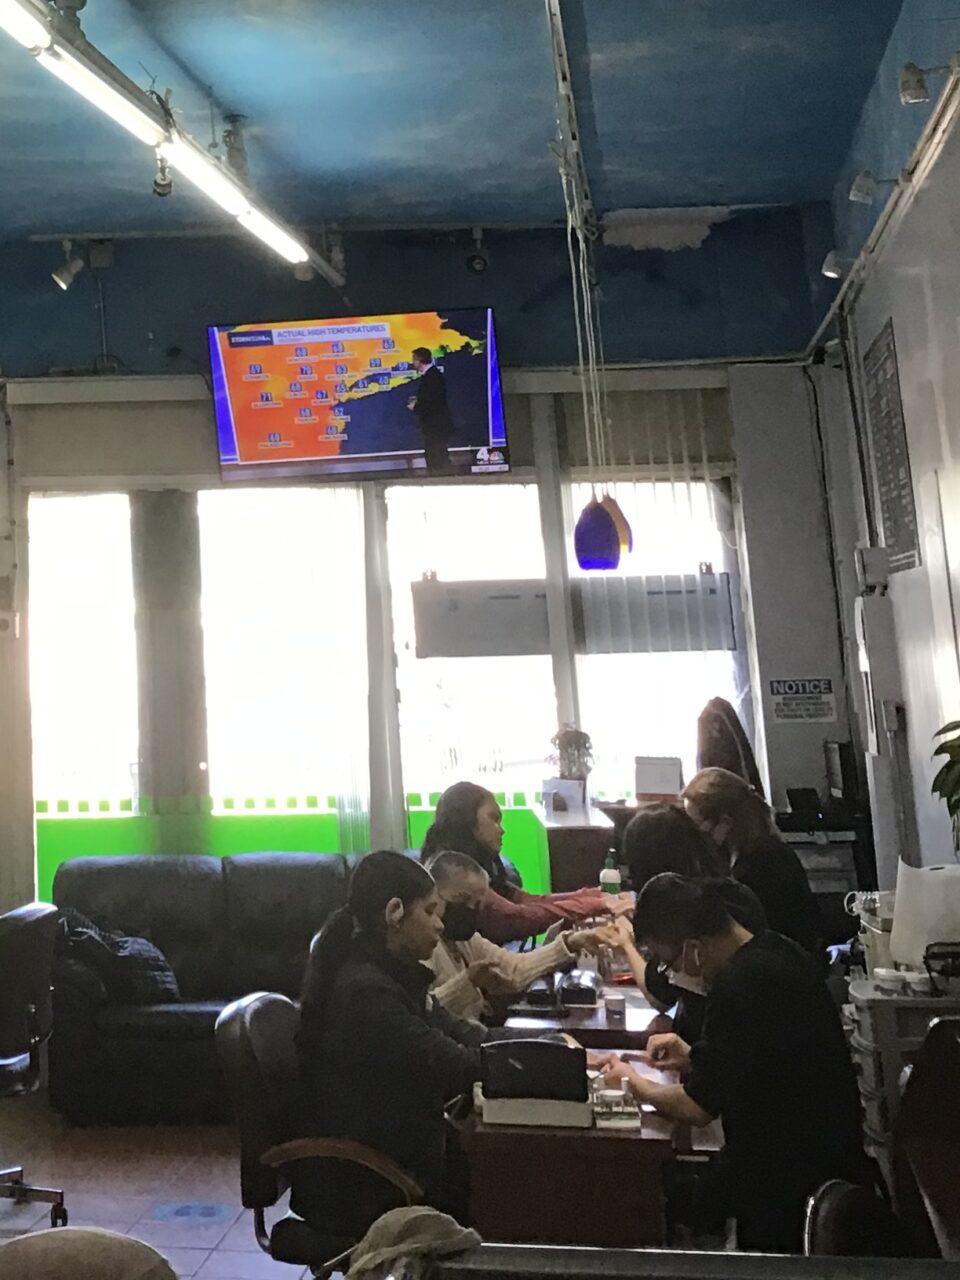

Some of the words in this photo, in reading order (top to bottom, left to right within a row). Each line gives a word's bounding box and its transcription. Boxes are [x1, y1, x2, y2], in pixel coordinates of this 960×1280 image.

[277, 329, 305, 338] ACTUAL
[307, 328, 326, 336] HIGH
[327, 324, 386, 335] TEMPERATURES
[476, 446, 489, 461] 4
[772, 680, 830, 695] NOTICE
